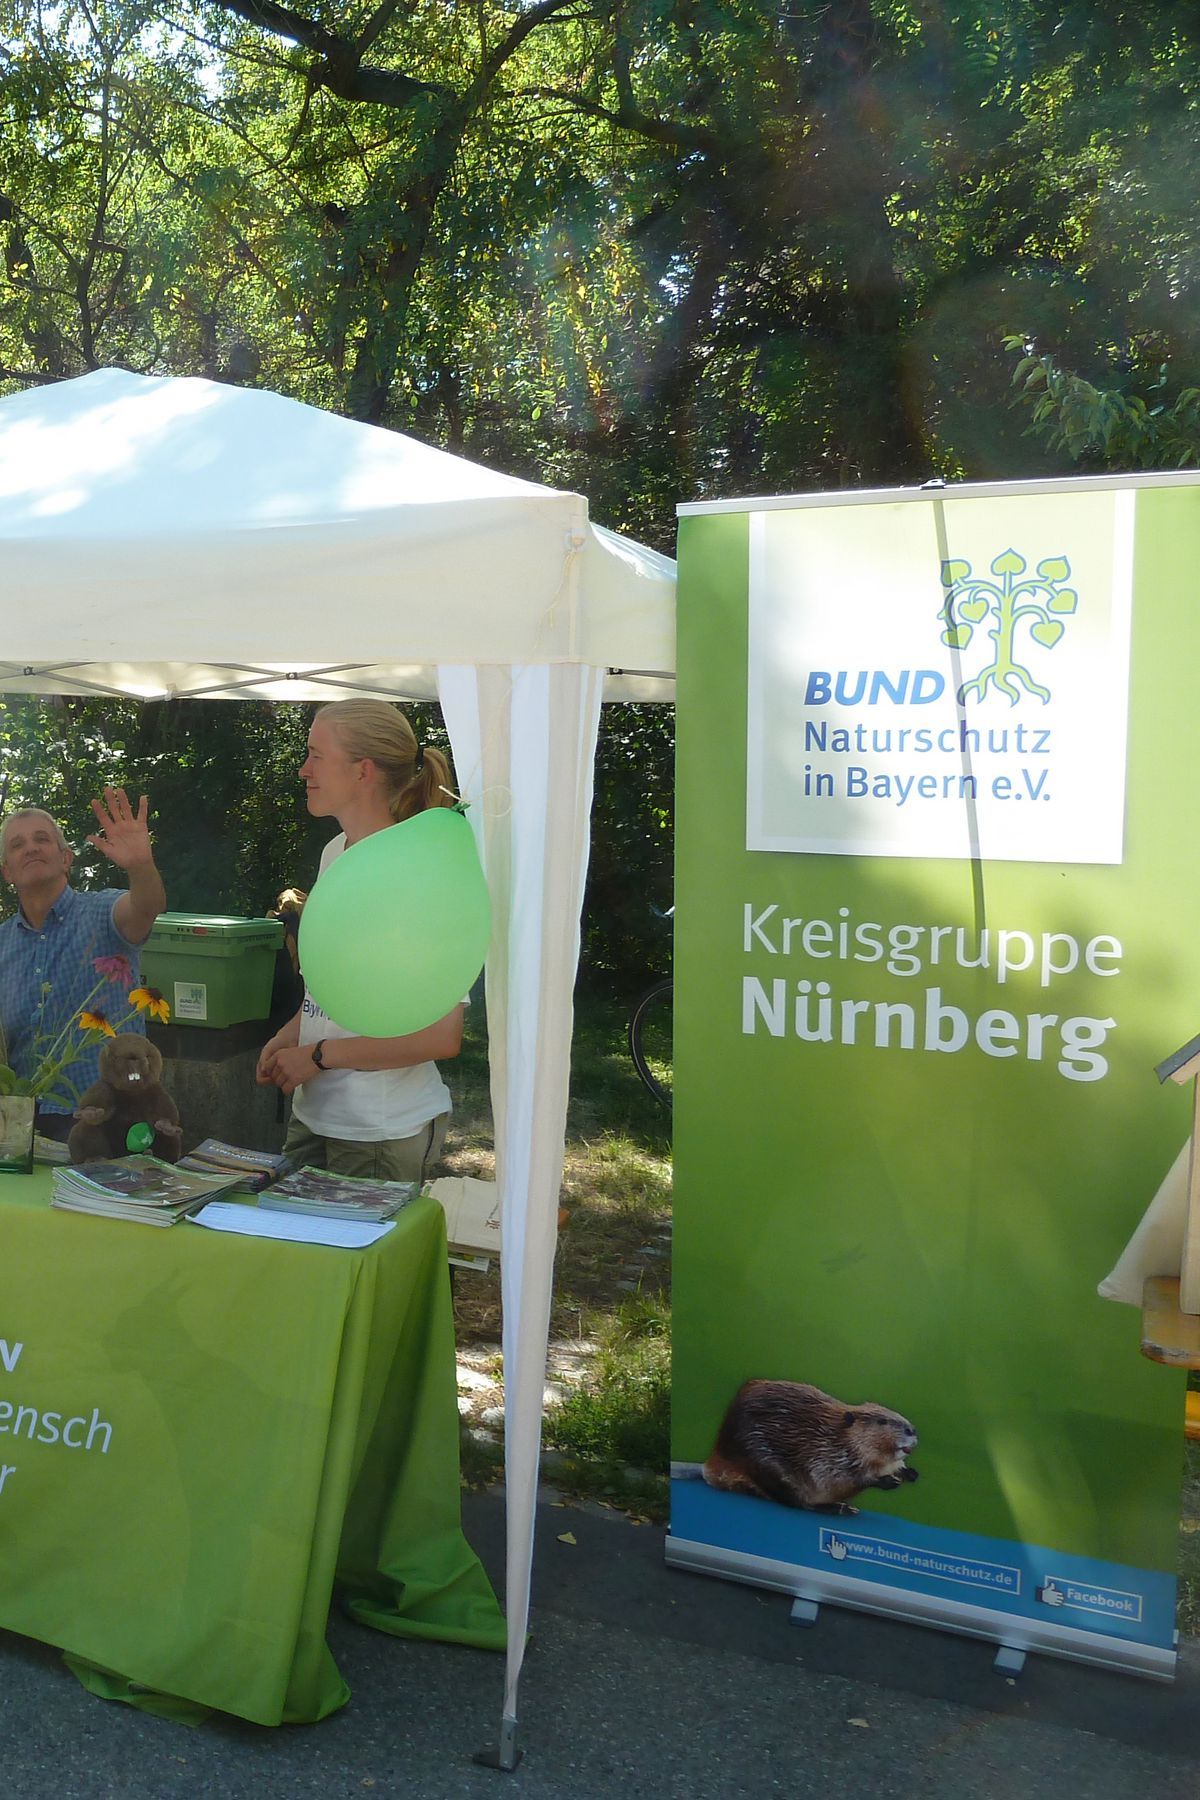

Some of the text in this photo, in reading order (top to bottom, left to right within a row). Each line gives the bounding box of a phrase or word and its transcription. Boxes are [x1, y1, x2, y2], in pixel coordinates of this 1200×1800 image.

[803, 669, 945, 707] BUND
[803, 720, 1052, 755] Naturschutz
[803, 765, 1052, 806] in Bayern e.V.
[742, 903, 1123, 987] Kreisgruppe
[741, 976, 1117, 1082] Nürnberg
[844, 1541, 1013, 1586] www.bund-naturschutz.de
[1066, 1587, 1134, 1613] Facebook
